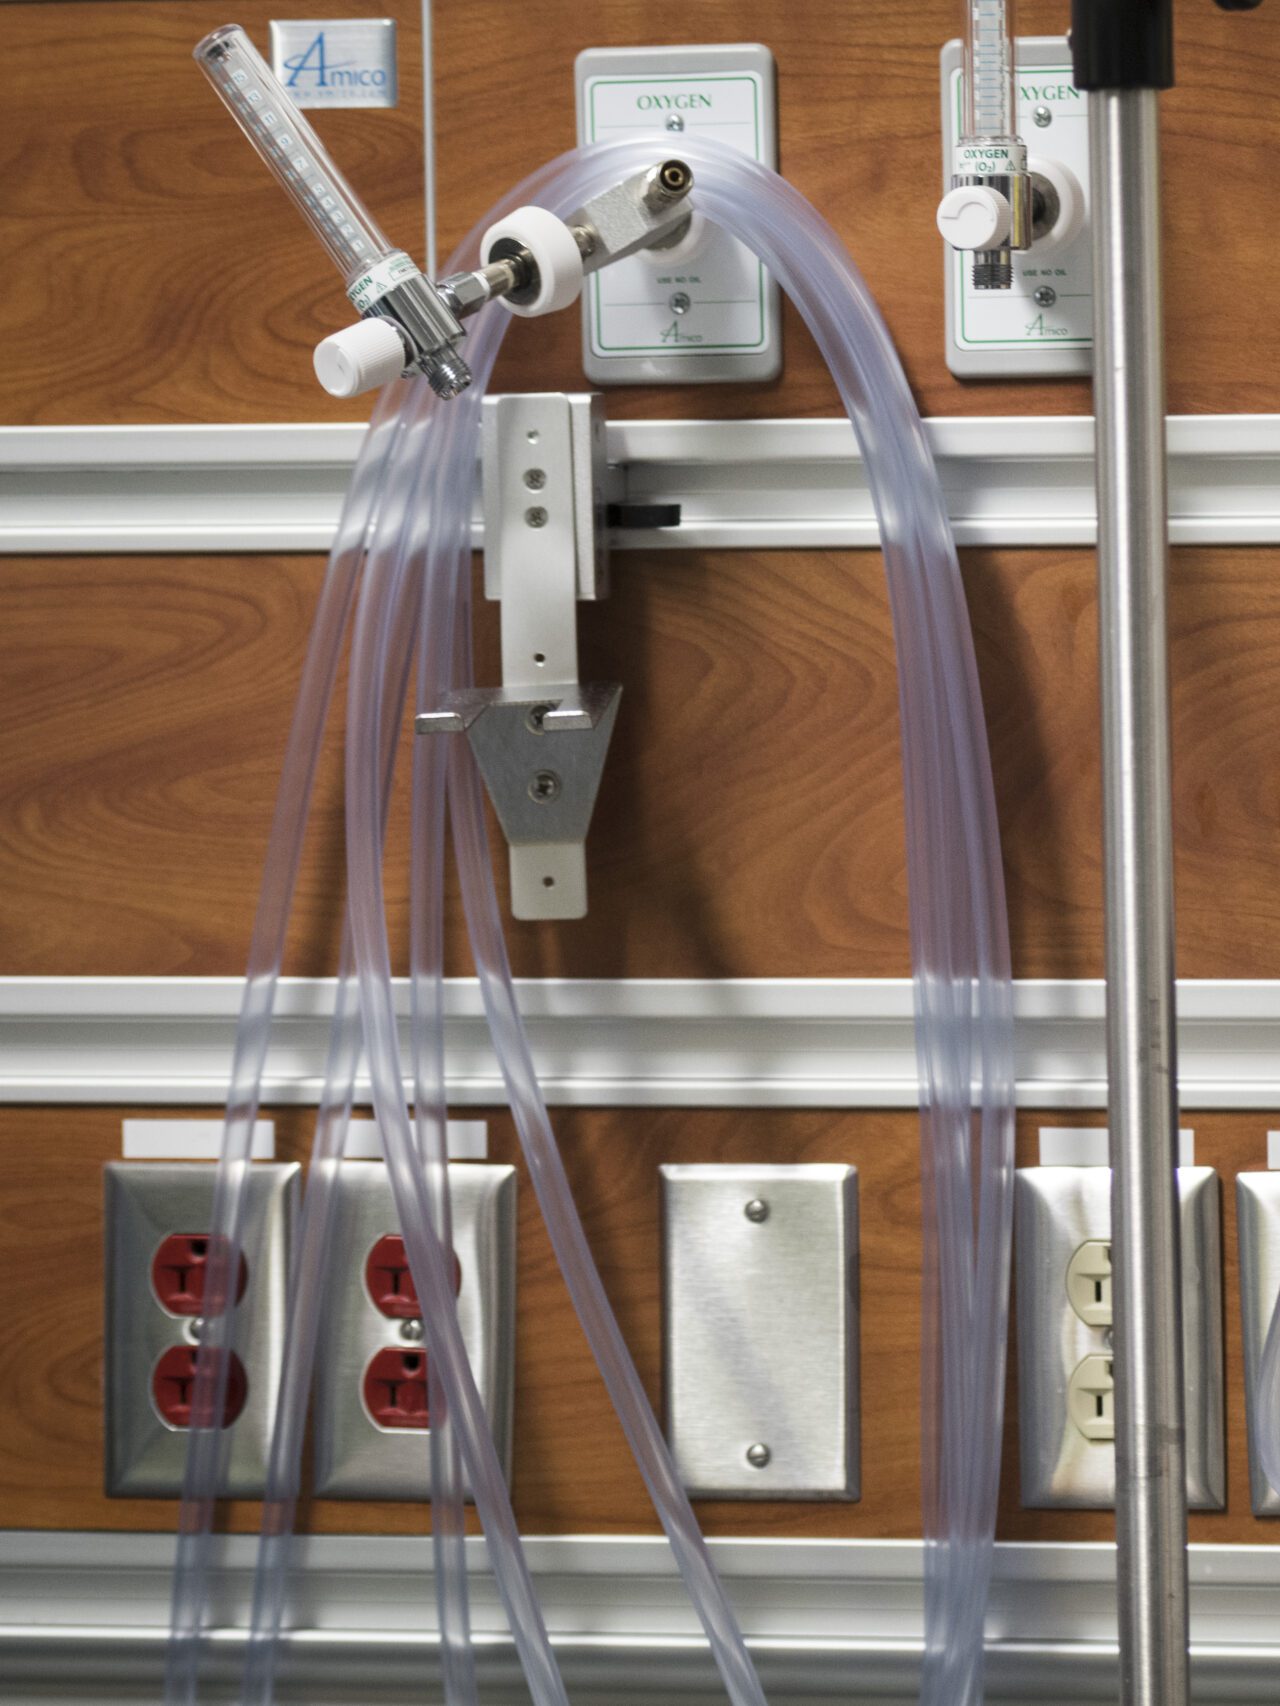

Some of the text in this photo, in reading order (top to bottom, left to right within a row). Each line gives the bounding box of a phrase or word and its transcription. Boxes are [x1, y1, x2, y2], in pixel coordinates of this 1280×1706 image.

[283, 31, 387, 88] Amico
[636, 93, 713, 111] OXYGEN
[1020, 84, 1081, 102] XYGEN
[963, 148, 1009, 160] OXYGEN
[1022, 269, 1038, 277] USE
[1040, 268, 1052, 276] NO
[1024, 312, 1069, 337] Amico
